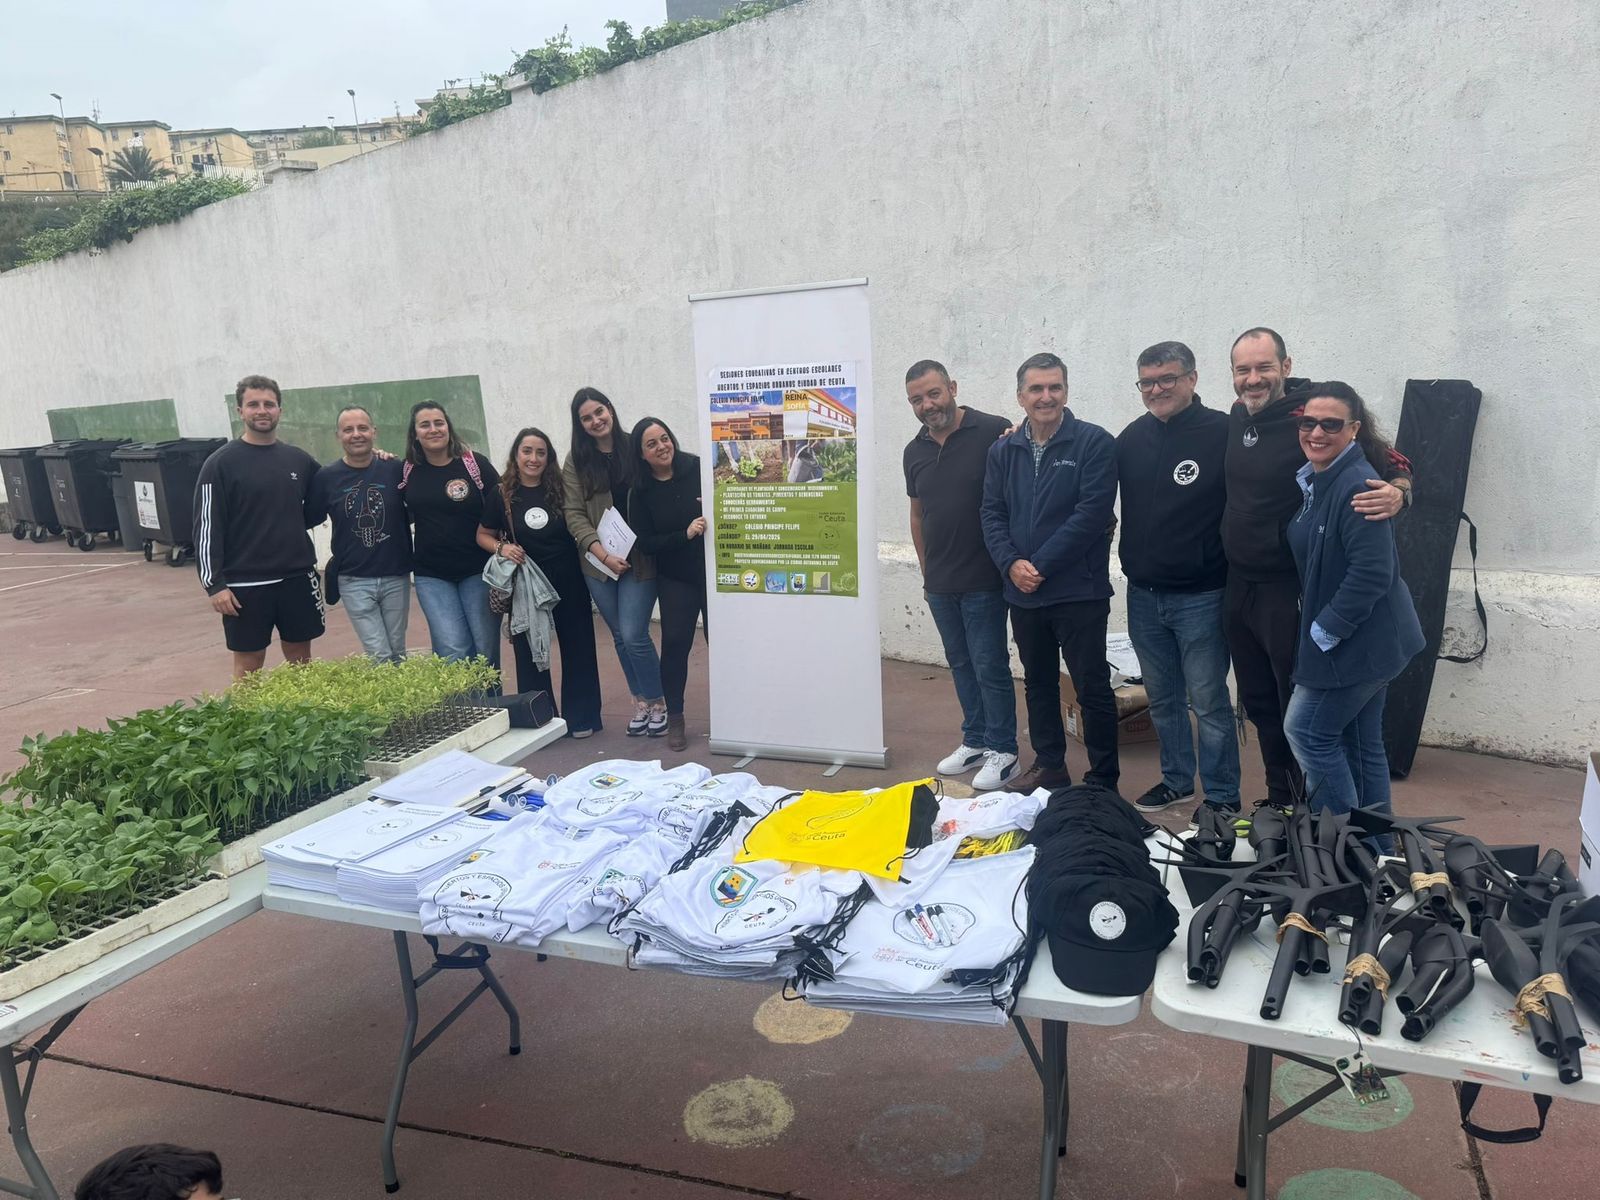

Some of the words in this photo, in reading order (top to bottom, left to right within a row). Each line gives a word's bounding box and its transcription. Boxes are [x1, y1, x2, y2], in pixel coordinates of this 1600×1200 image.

[745, 368, 776, 378] EDUCATIVAS
[778, 368, 785, 376] EN
[786, 366, 810, 375] CENTROS
[812, 364, 842, 374] ESCOLARES
[746, 381, 771, 390] ESPACIOS
[828, 377, 846, 386] CEUTA
[785, 393, 808, 401] REINA
[812, 832, 846, 841] Ceuta
